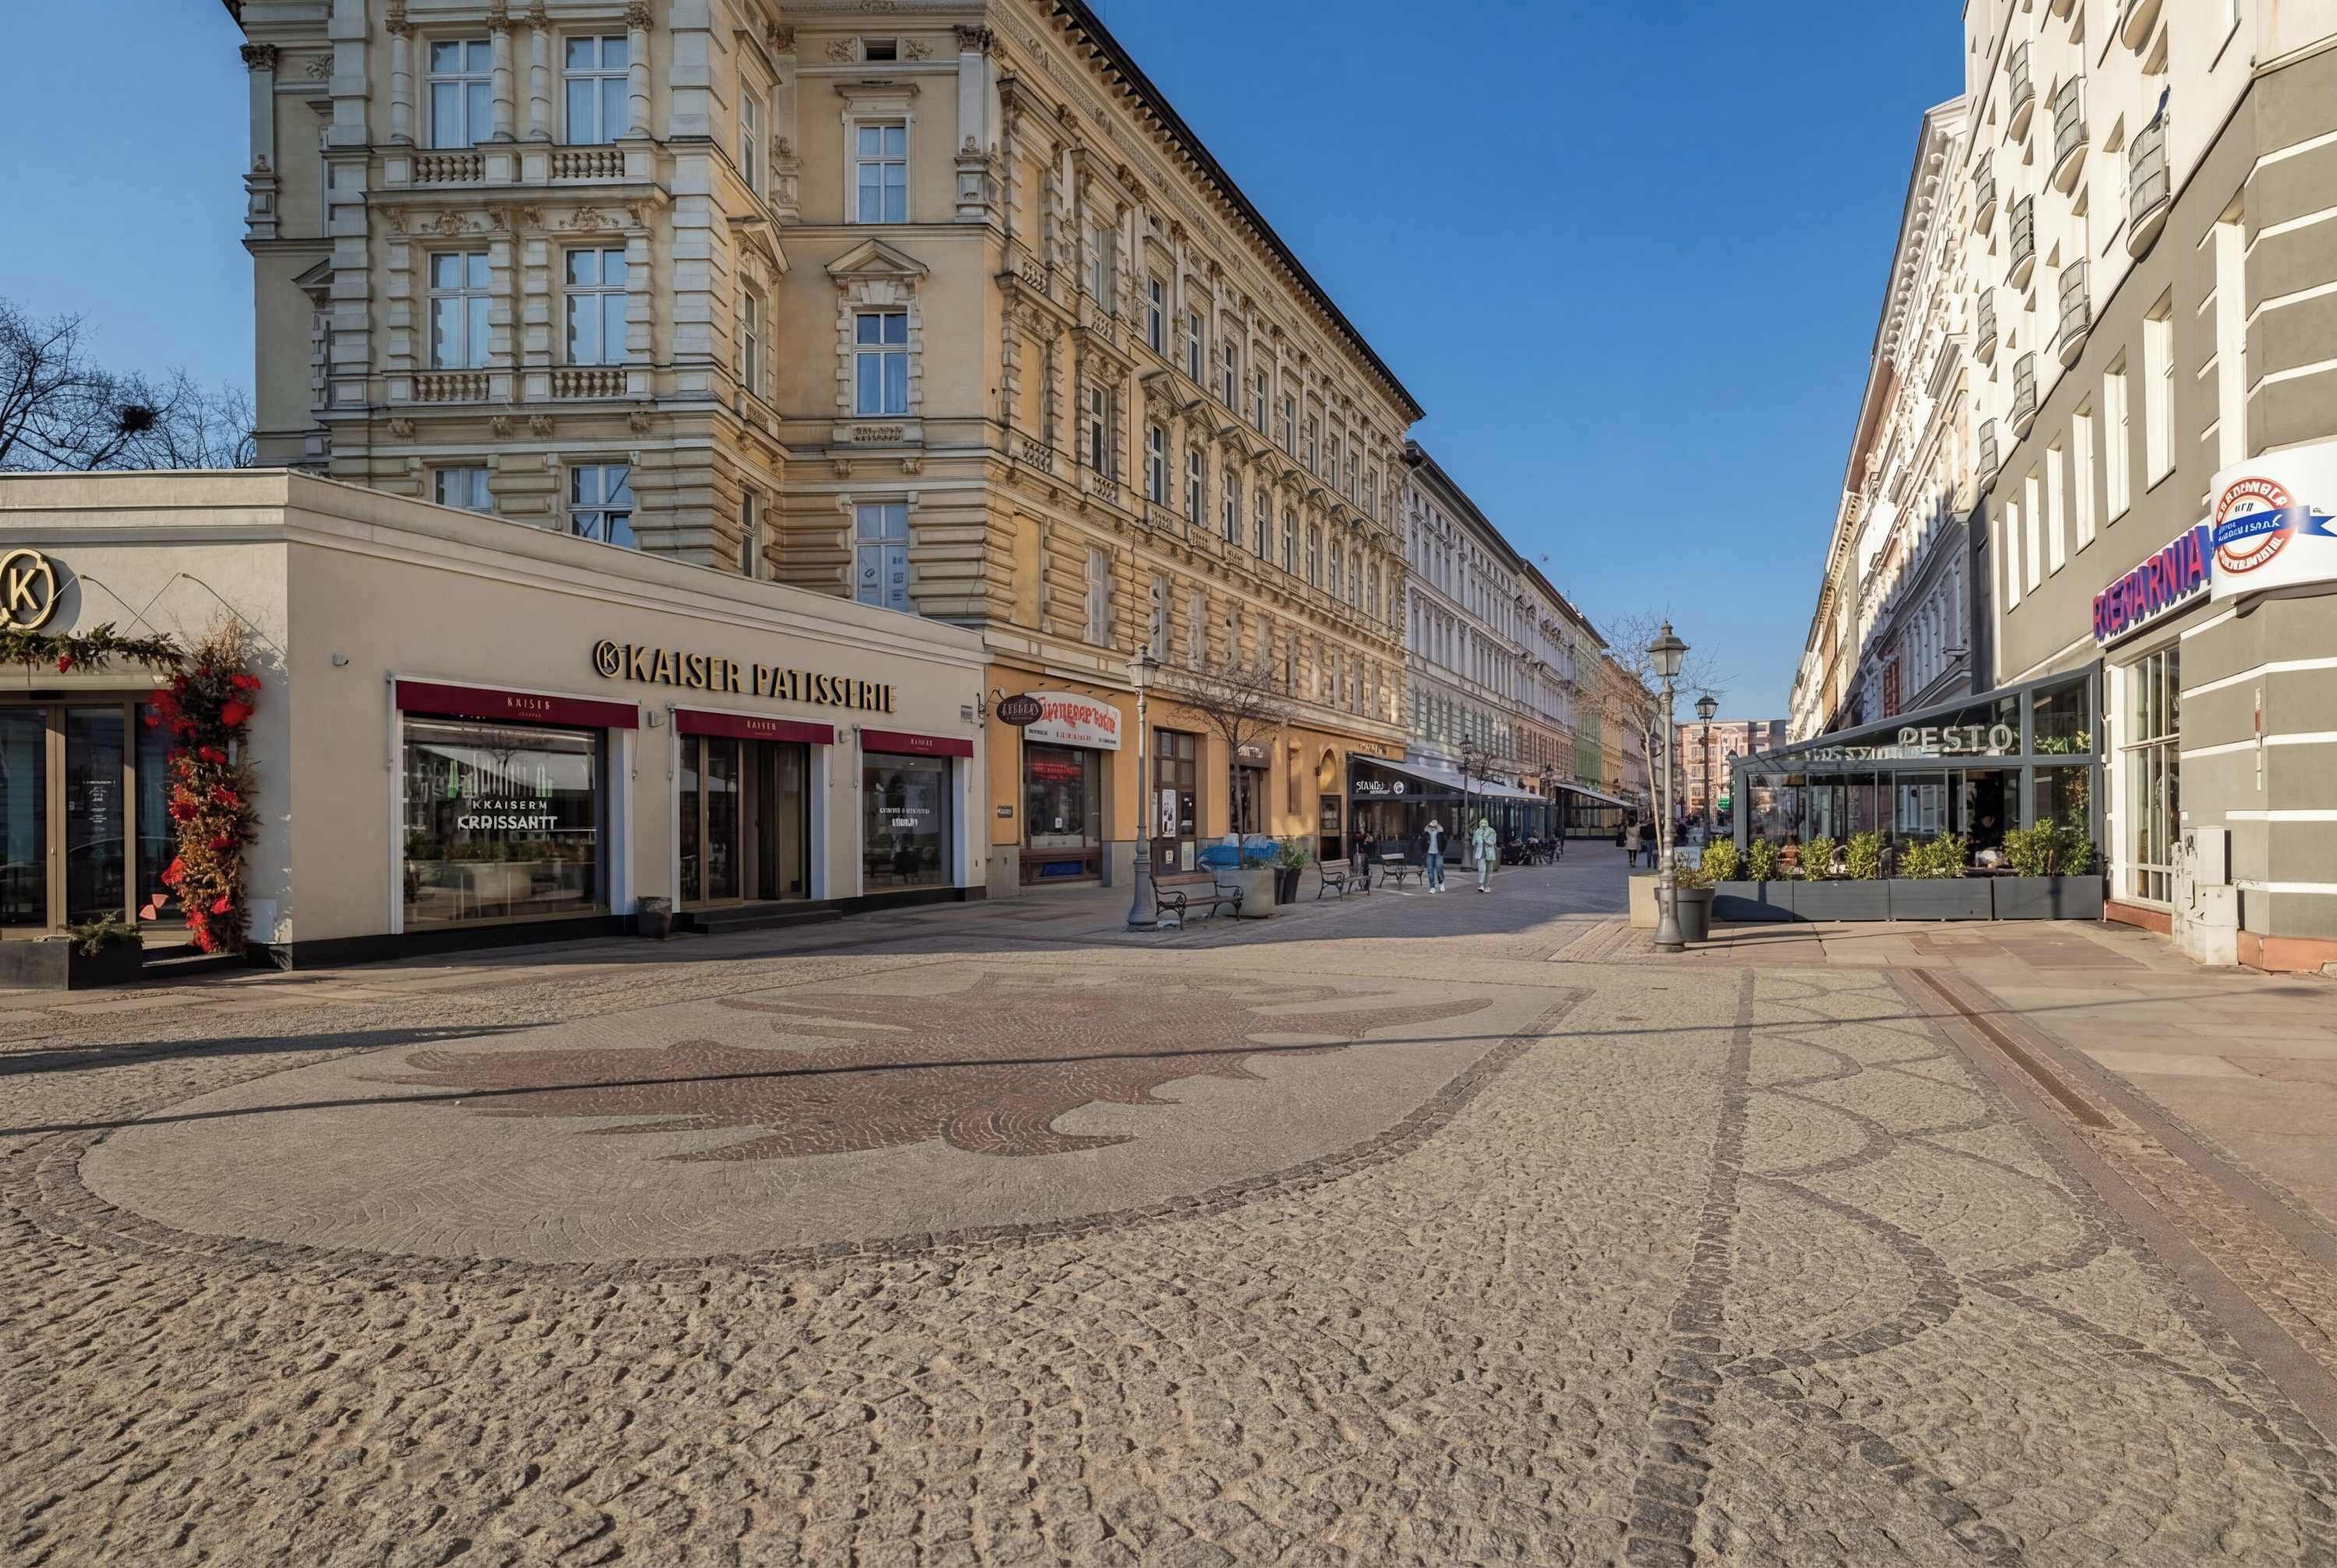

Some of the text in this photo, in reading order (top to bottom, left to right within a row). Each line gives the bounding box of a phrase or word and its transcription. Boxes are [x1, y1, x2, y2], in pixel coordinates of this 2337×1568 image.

[626, 643, 746, 692] KAISER
[753, 664, 897, 713] PATISSERIE
[1898, 723, 2013, 753] PESTO
